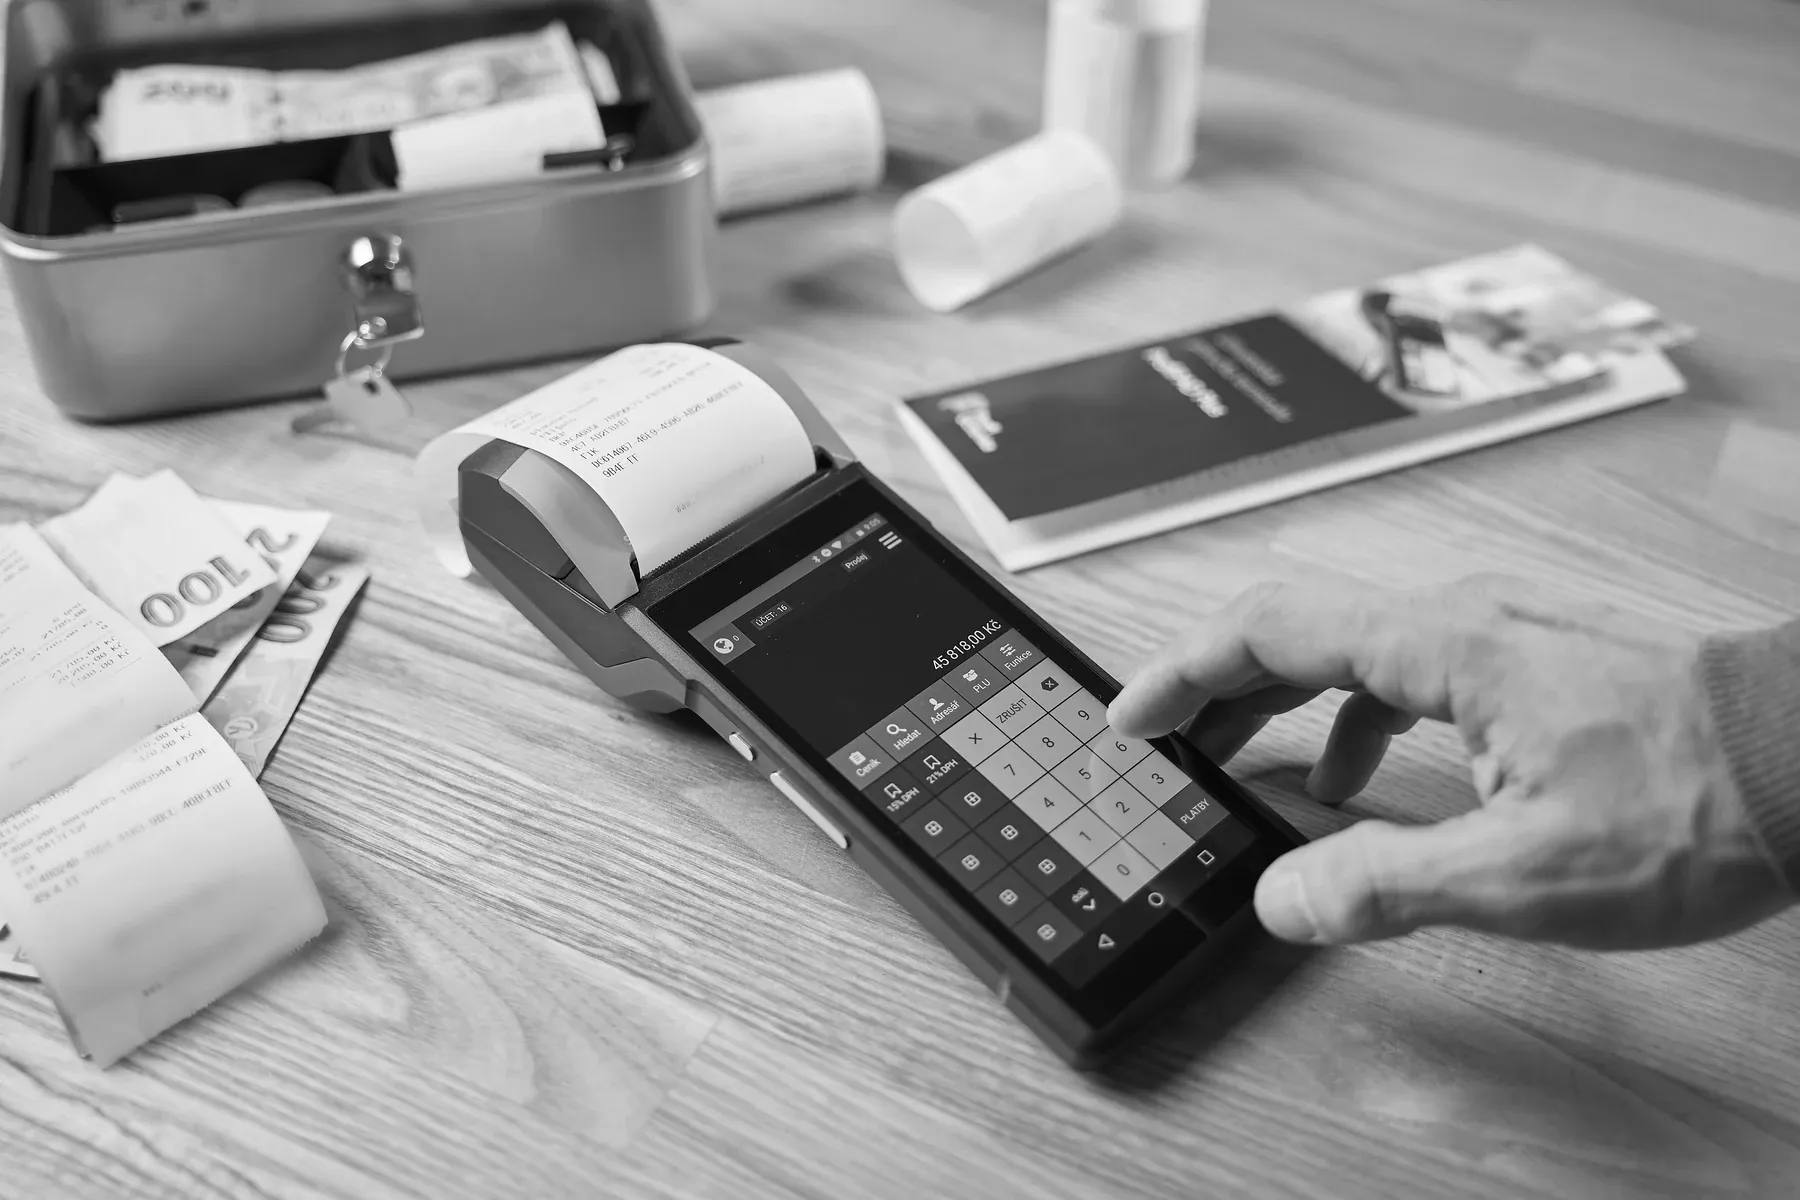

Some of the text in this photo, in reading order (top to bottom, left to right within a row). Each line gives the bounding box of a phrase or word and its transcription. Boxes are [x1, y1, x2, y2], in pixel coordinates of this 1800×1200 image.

[844, 552, 869, 570] Prodej
[140, 555, 251, 628] 100
[777, 603, 788, 614] 16
[932, 618, 1002, 671] 45 818,00 Kč
[1004, 648, 1033, 671] Funkce
[972, 678, 991, 693] PLU
[930, 699, 961, 725] Adresář
[995, 698, 1028, 724] ZRUŠIT
[1077, 709, 1090, 721] 9
[893, 728, 922, 751] Hledat
[1041, 736, 1055, 749] 8
[1114, 740, 1128, 753] 6
[940, 757, 959, 775] DPH
[1003, 763, 1017, 777] 7
[1078, 767, 1092, 780] 5
[1150, 772, 1165, 785] 3
[1043, 796, 1056, 809] 4
[1114, 801, 1131, 814] 2
[1179, 798, 1211, 825] PLATBY
[1078, 830, 1092, 842] 1
[1116, 862, 1131, 876] 0
